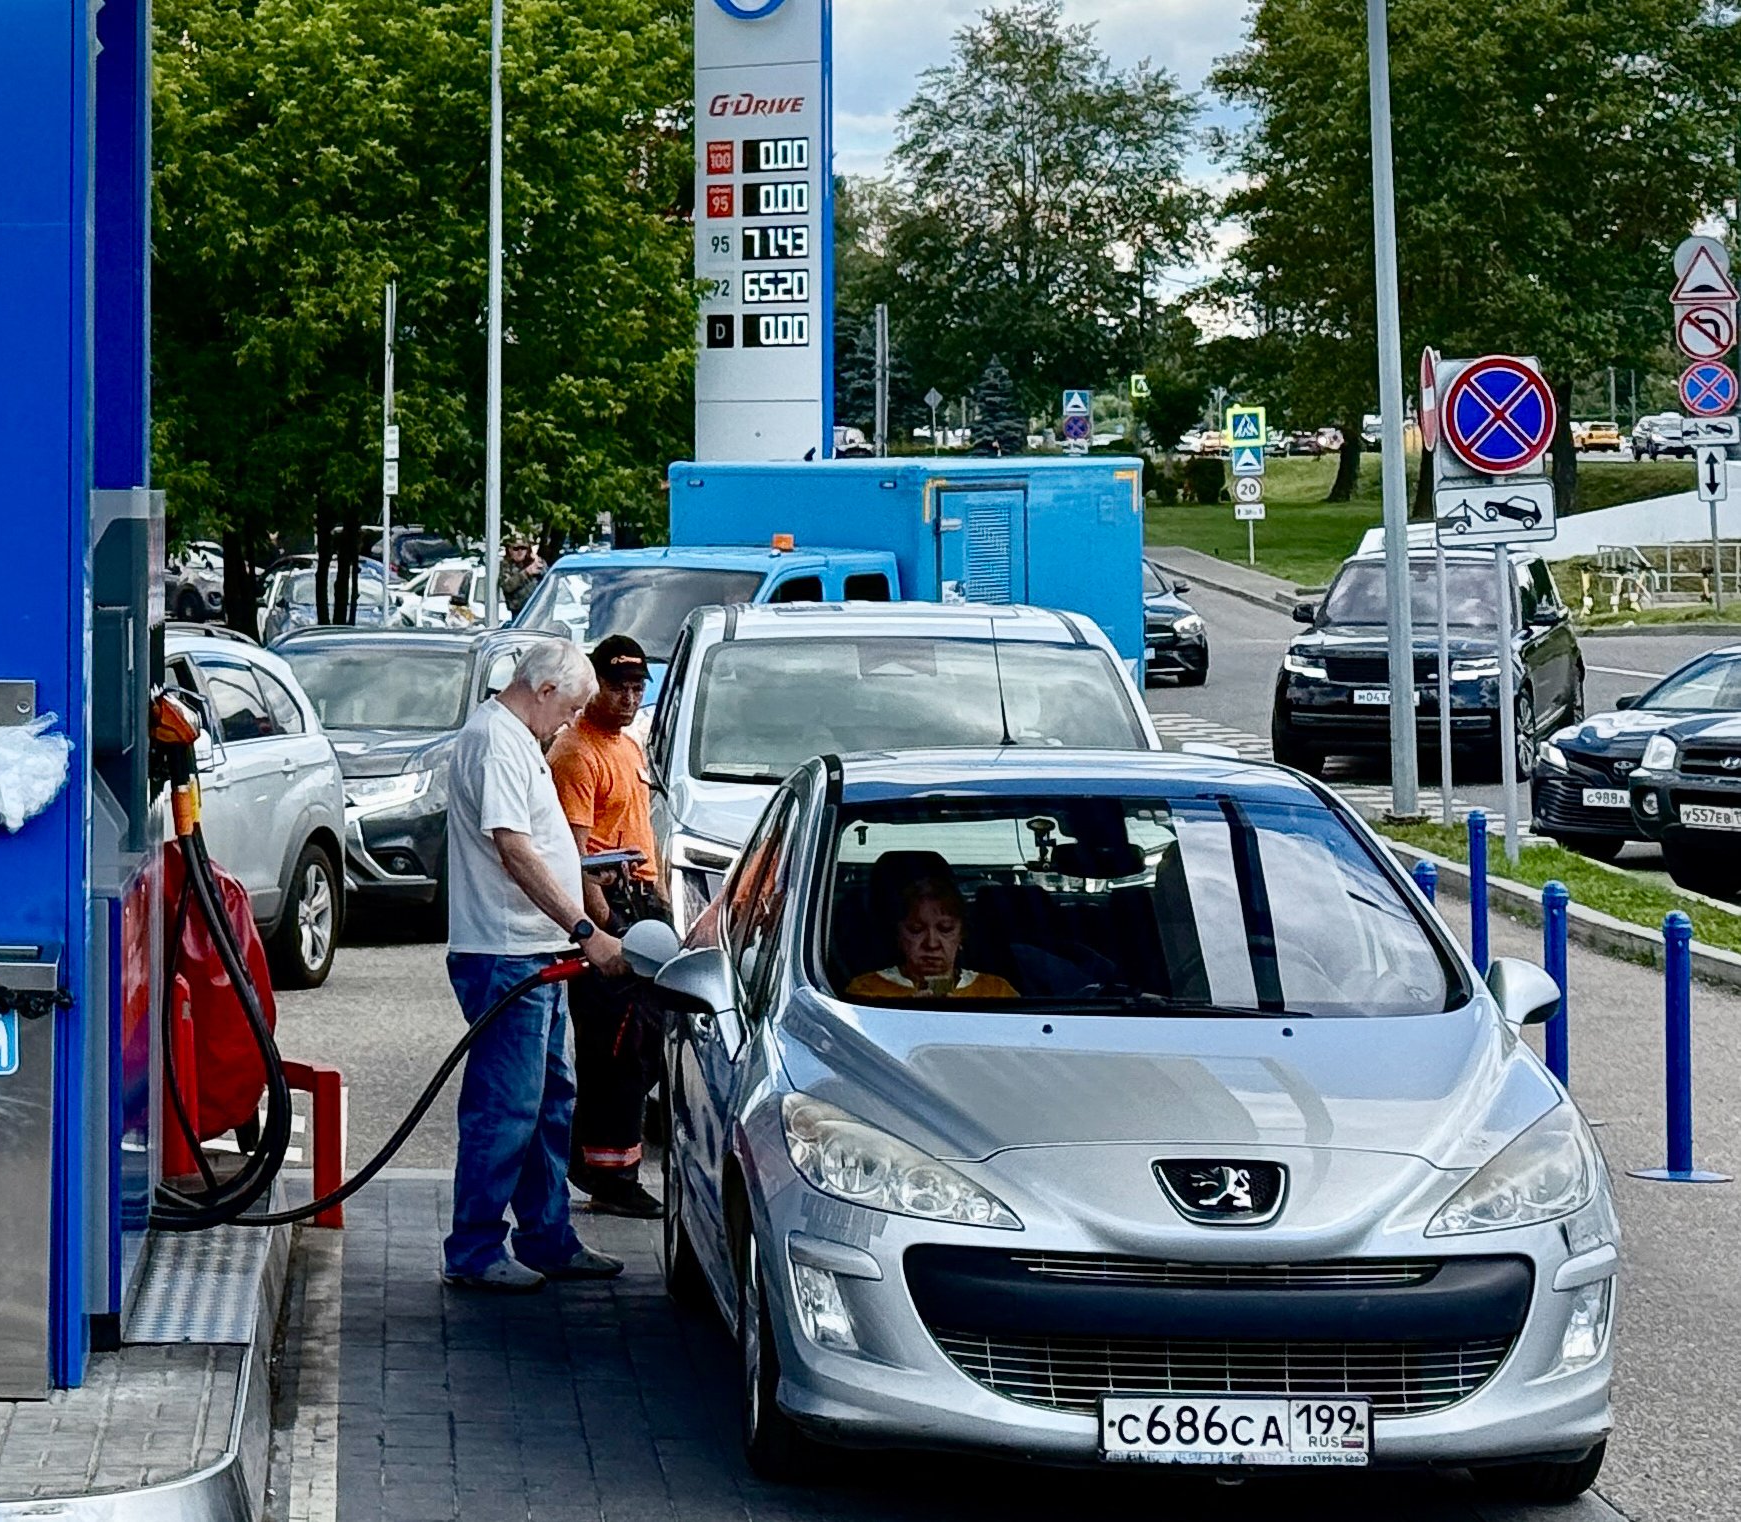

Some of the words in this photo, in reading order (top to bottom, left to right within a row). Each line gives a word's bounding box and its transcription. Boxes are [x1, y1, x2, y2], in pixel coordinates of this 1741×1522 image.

[710, 152, 731, 169] 100
[712, 195, 729, 213] 95
[711, 236, 730, 253] 95
[715, 323, 726, 340] D
[1240, 483, 1257, 495] 20
[1586, 792, 1626, 805] С988А
[1117, 1404, 1285, 1447] С686СА
[1294, 1403, 1357, 1436] 199
[1308, 1436, 1340, 1449] RUS
